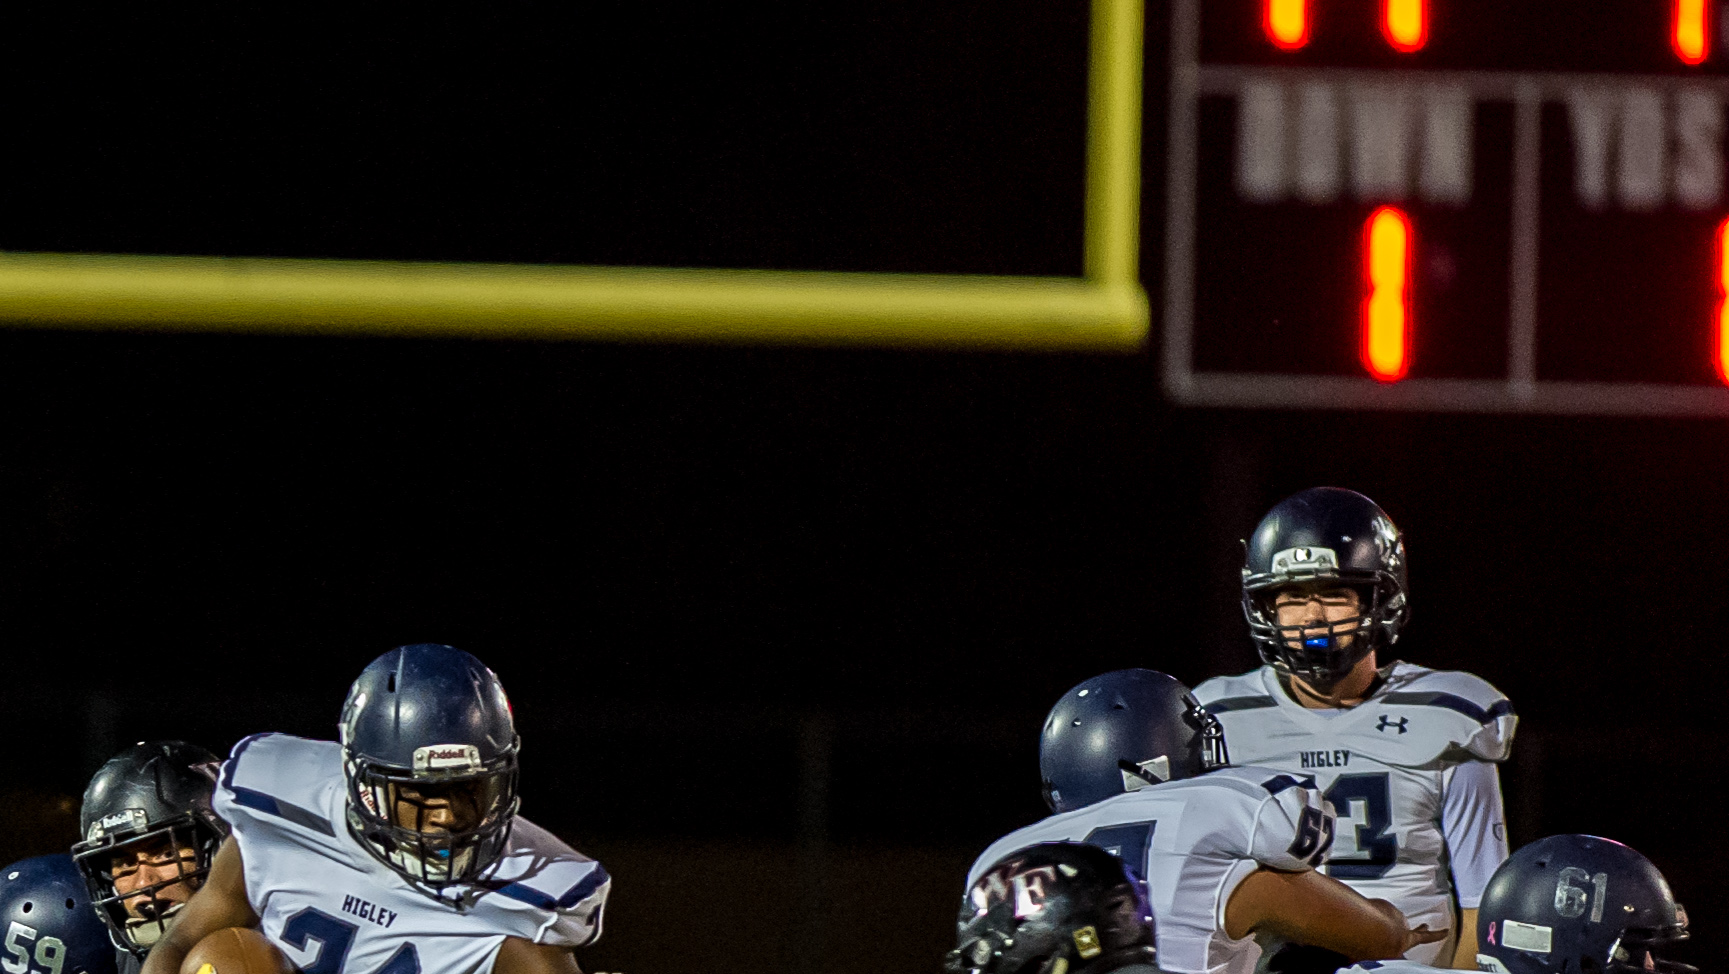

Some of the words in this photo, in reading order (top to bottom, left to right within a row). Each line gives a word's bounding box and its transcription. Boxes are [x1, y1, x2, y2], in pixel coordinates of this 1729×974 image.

[1361, 206, 1413, 383] 1
[1300, 750, 1351, 769] HIGLEY
[1293, 772, 1397, 881] 3
[342, 893, 398, 929] HIGLEY
[1553, 866, 1608, 924] 61
